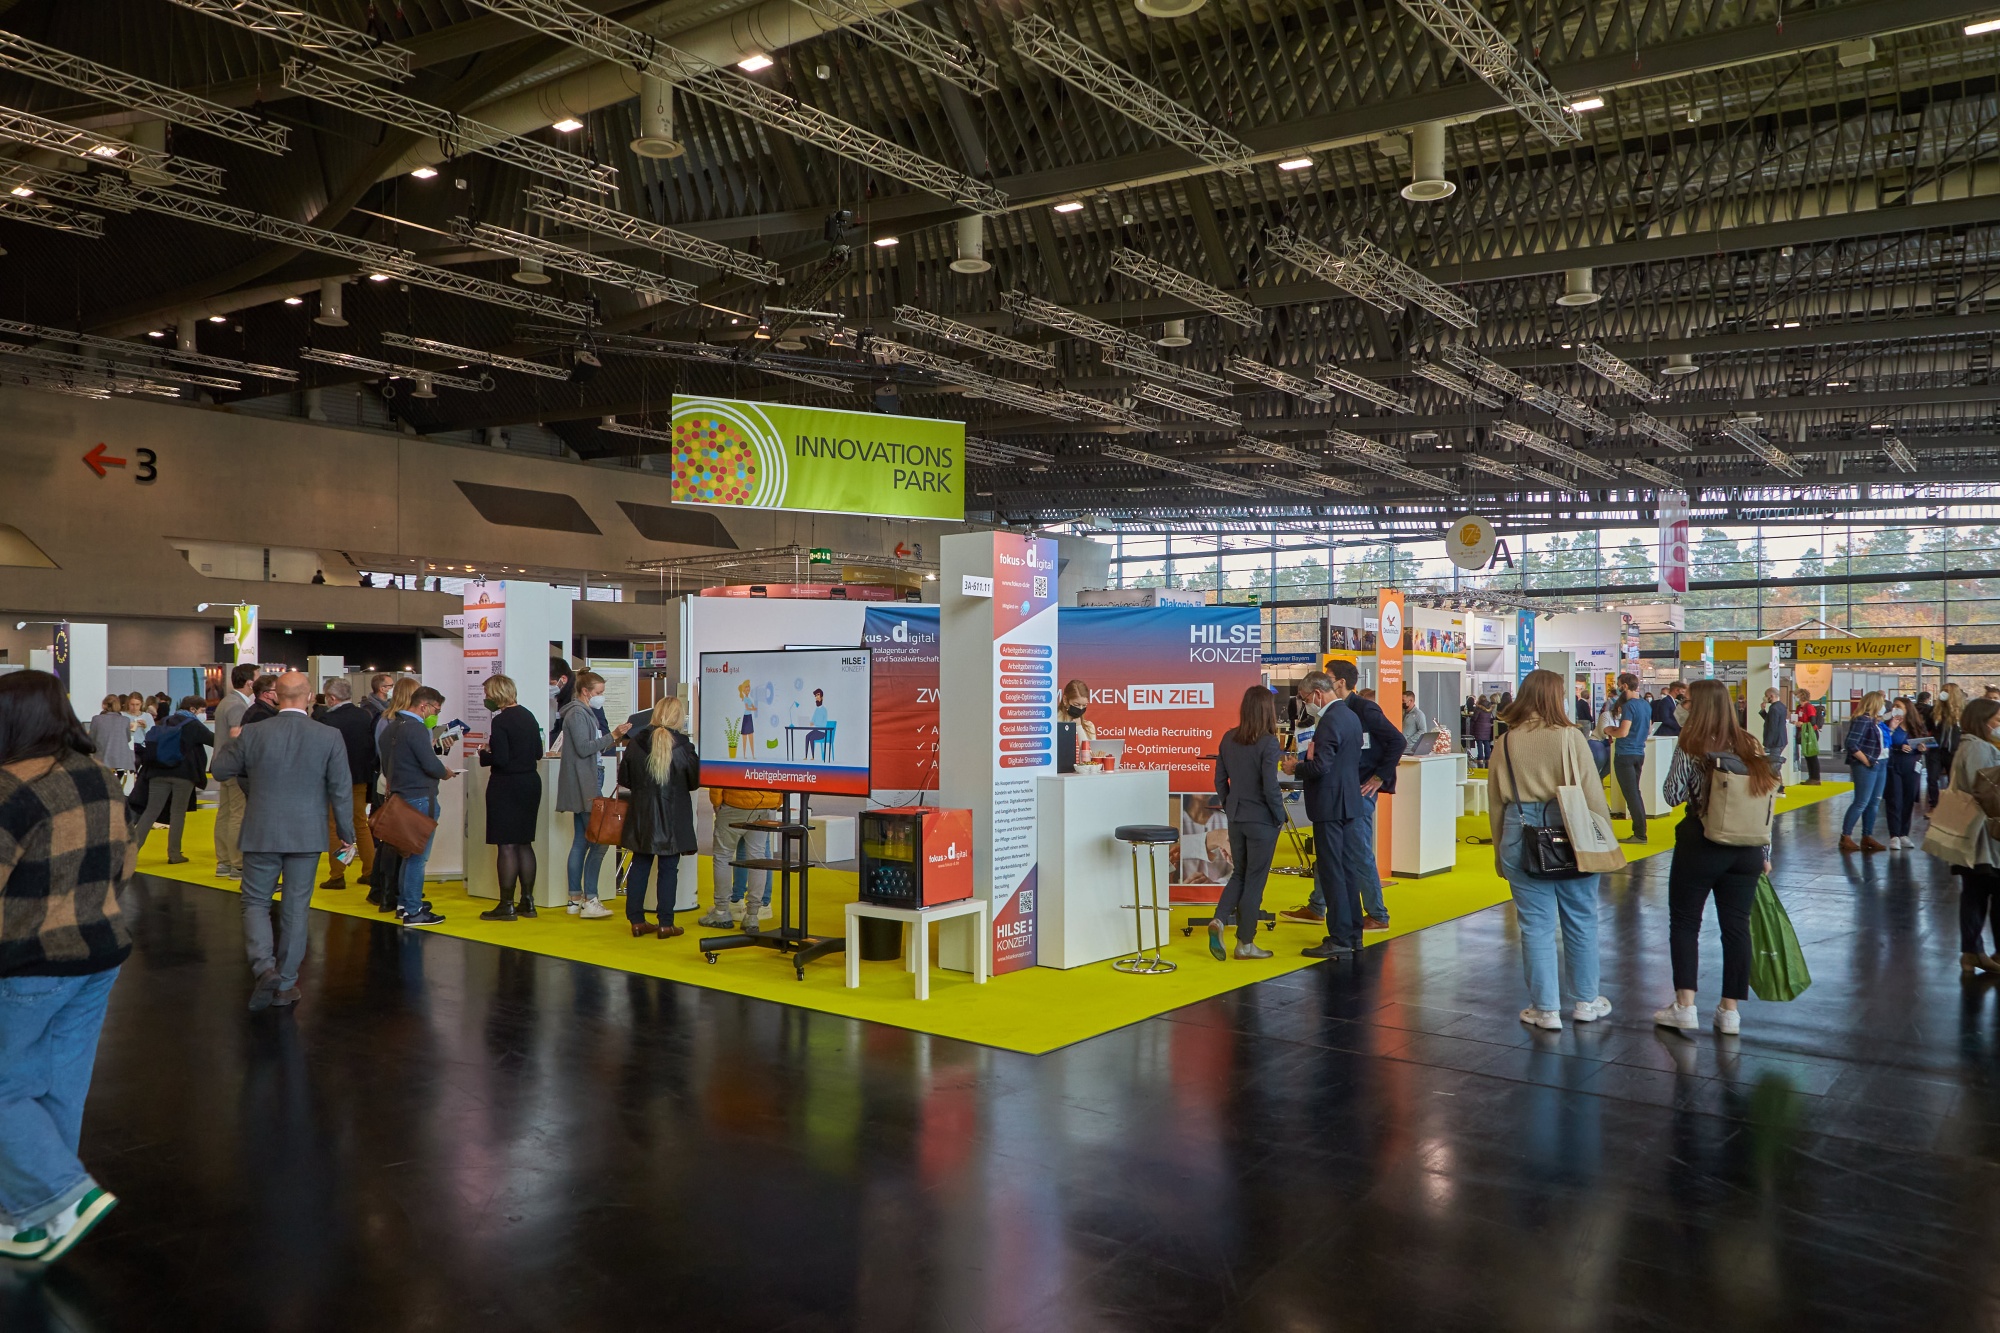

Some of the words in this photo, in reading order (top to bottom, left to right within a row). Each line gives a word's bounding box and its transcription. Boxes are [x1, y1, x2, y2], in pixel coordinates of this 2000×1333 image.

[795, 434, 953, 469] INNOVATIONS
[136, 448, 158, 482] 3
[893, 469, 952, 493] PARK
[999, 553, 1020, 566] fokus
[1026, 544, 1054, 571] digital
[1489, 539, 1515, 570] A
[964, 580, 991, 592] 3A-611.11
[892, 620, 936, 645] digital
[1190, 624, 1261, 644] HILSE
[1803, 643, 1852, 656] Regens
[1855, 641, 1913, 656] Wagner
[889, 655, 940, 663] Sozialwirtschaft
[1007, 662, 1045, 672] Arbeitgebermarke
[705, 666, 719, 674] fokus
[1133, 689, 1163, 704] EIN
[1168, 689, 1210, 705] ZIEL
[1002, 725, 1016, 733] Social
[1029, 725, 1049, 733] Recruiting
[1096, 726, 1126, 736] Social
[1128, 727, 1159, 737] Media
[1161, 727, 1213, 739] Recruiting
[1139, 762, 1147, 770] &
[1148, 762, 1211, 771] Karriereseite
[744, 768, 817, 784] Arbeitgebermarke
[928, 854, 944, 864] fokus
[947, 842, 968, 861] digital
[996, 934, 1033, 952] KONZEPT
